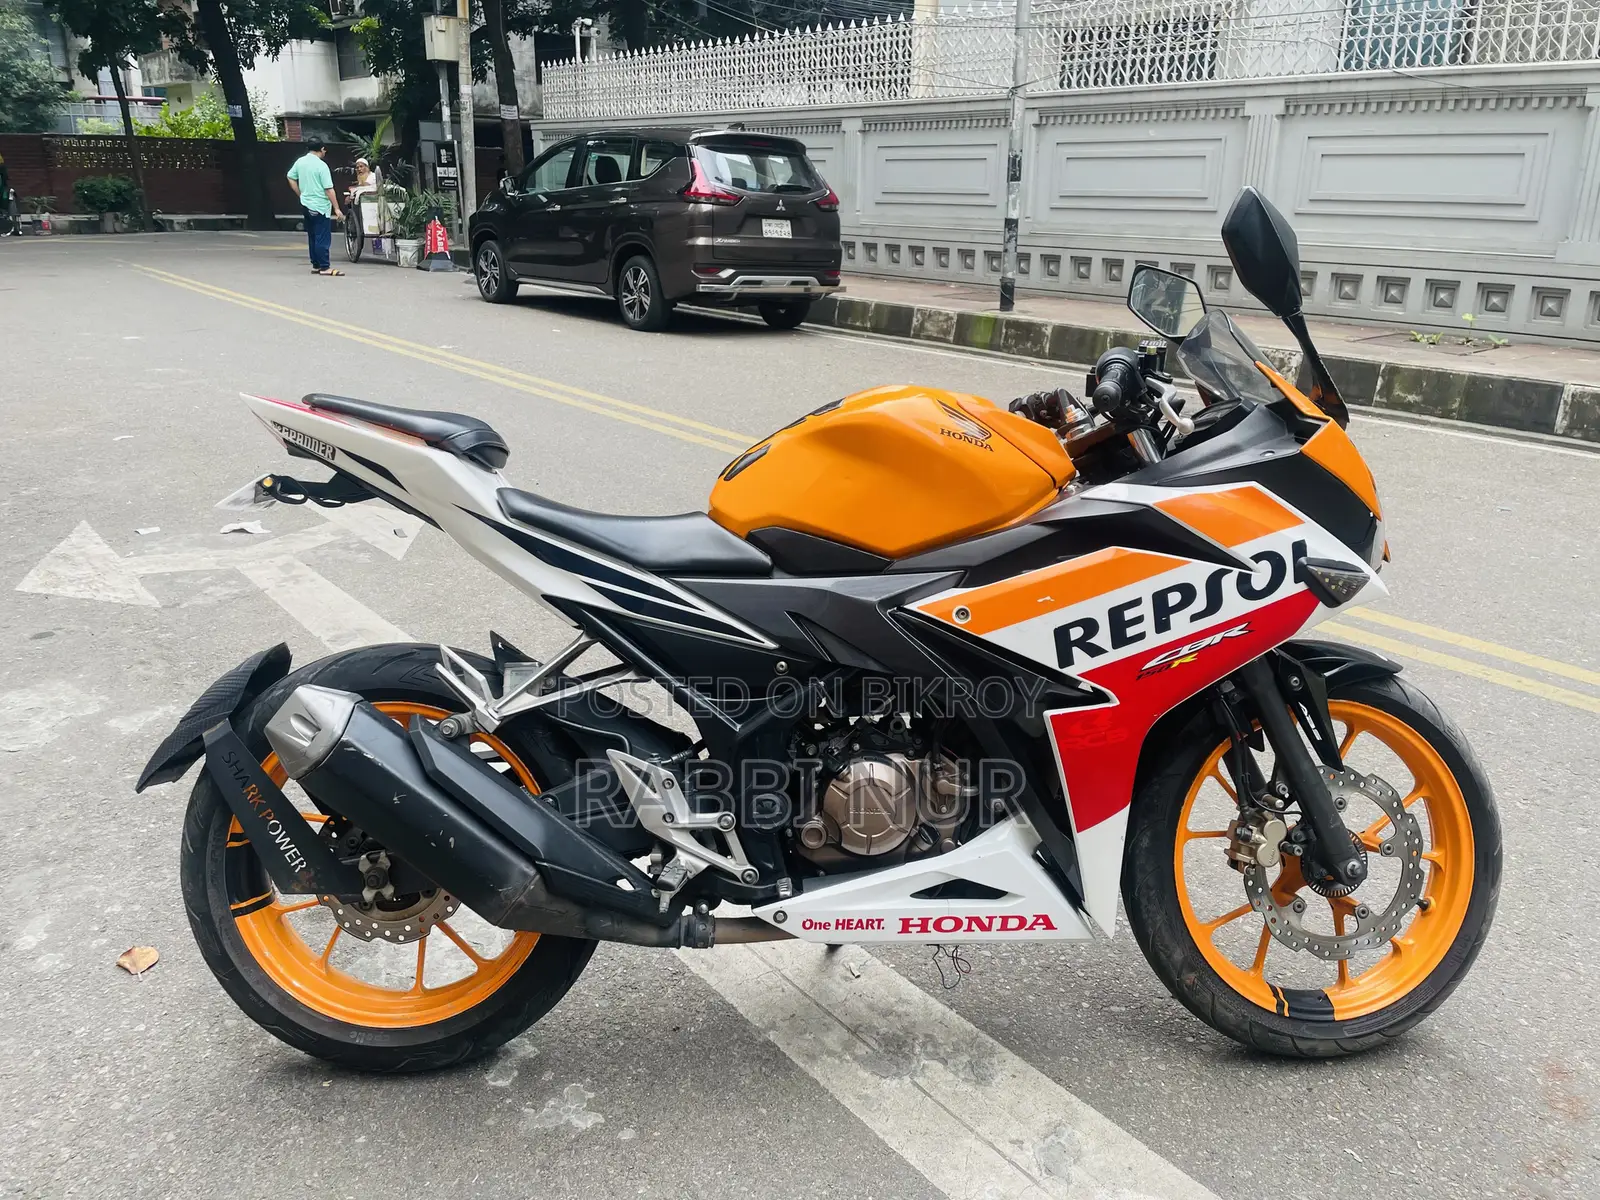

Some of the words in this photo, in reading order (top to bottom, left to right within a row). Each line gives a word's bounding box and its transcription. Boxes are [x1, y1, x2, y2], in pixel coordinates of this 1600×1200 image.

[940, 427, 994, 452] HONDA
[1053, 539, 1308, 669] REPSOL
[1141, 621, 1254, 671] CBR
[221, 751, 266, 811] SHARK
[258, 808, 307, 873] POWER
[801, 918, 831, 931] One
[835, 918, 885, 930] HEART.
[896, 914, 1058, 934] HONDA
